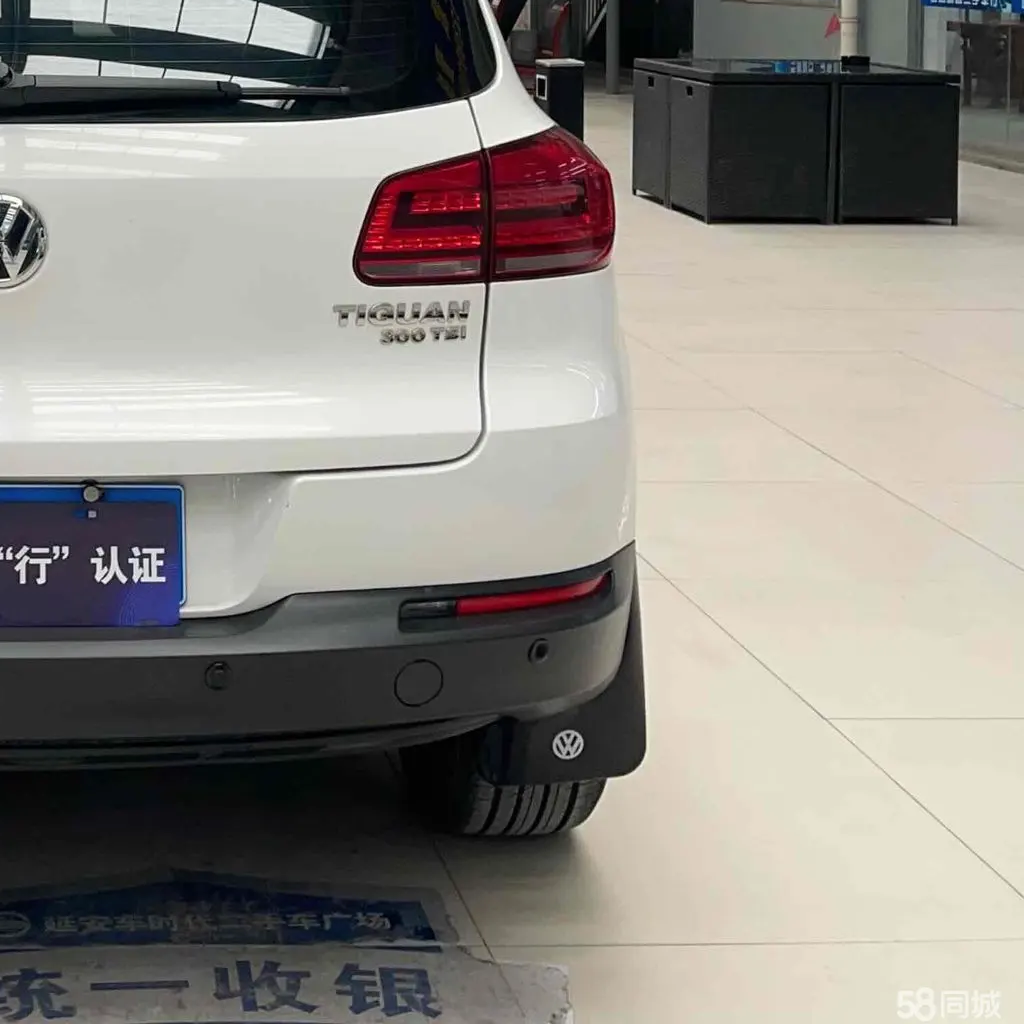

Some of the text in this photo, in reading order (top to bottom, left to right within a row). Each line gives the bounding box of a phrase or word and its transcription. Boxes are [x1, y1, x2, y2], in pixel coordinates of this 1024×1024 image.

[332, 300, 471, 327] TIGUAN
[380, 325, 467, 344] 300 TSI
[90, 546, 166, 585] 认证
